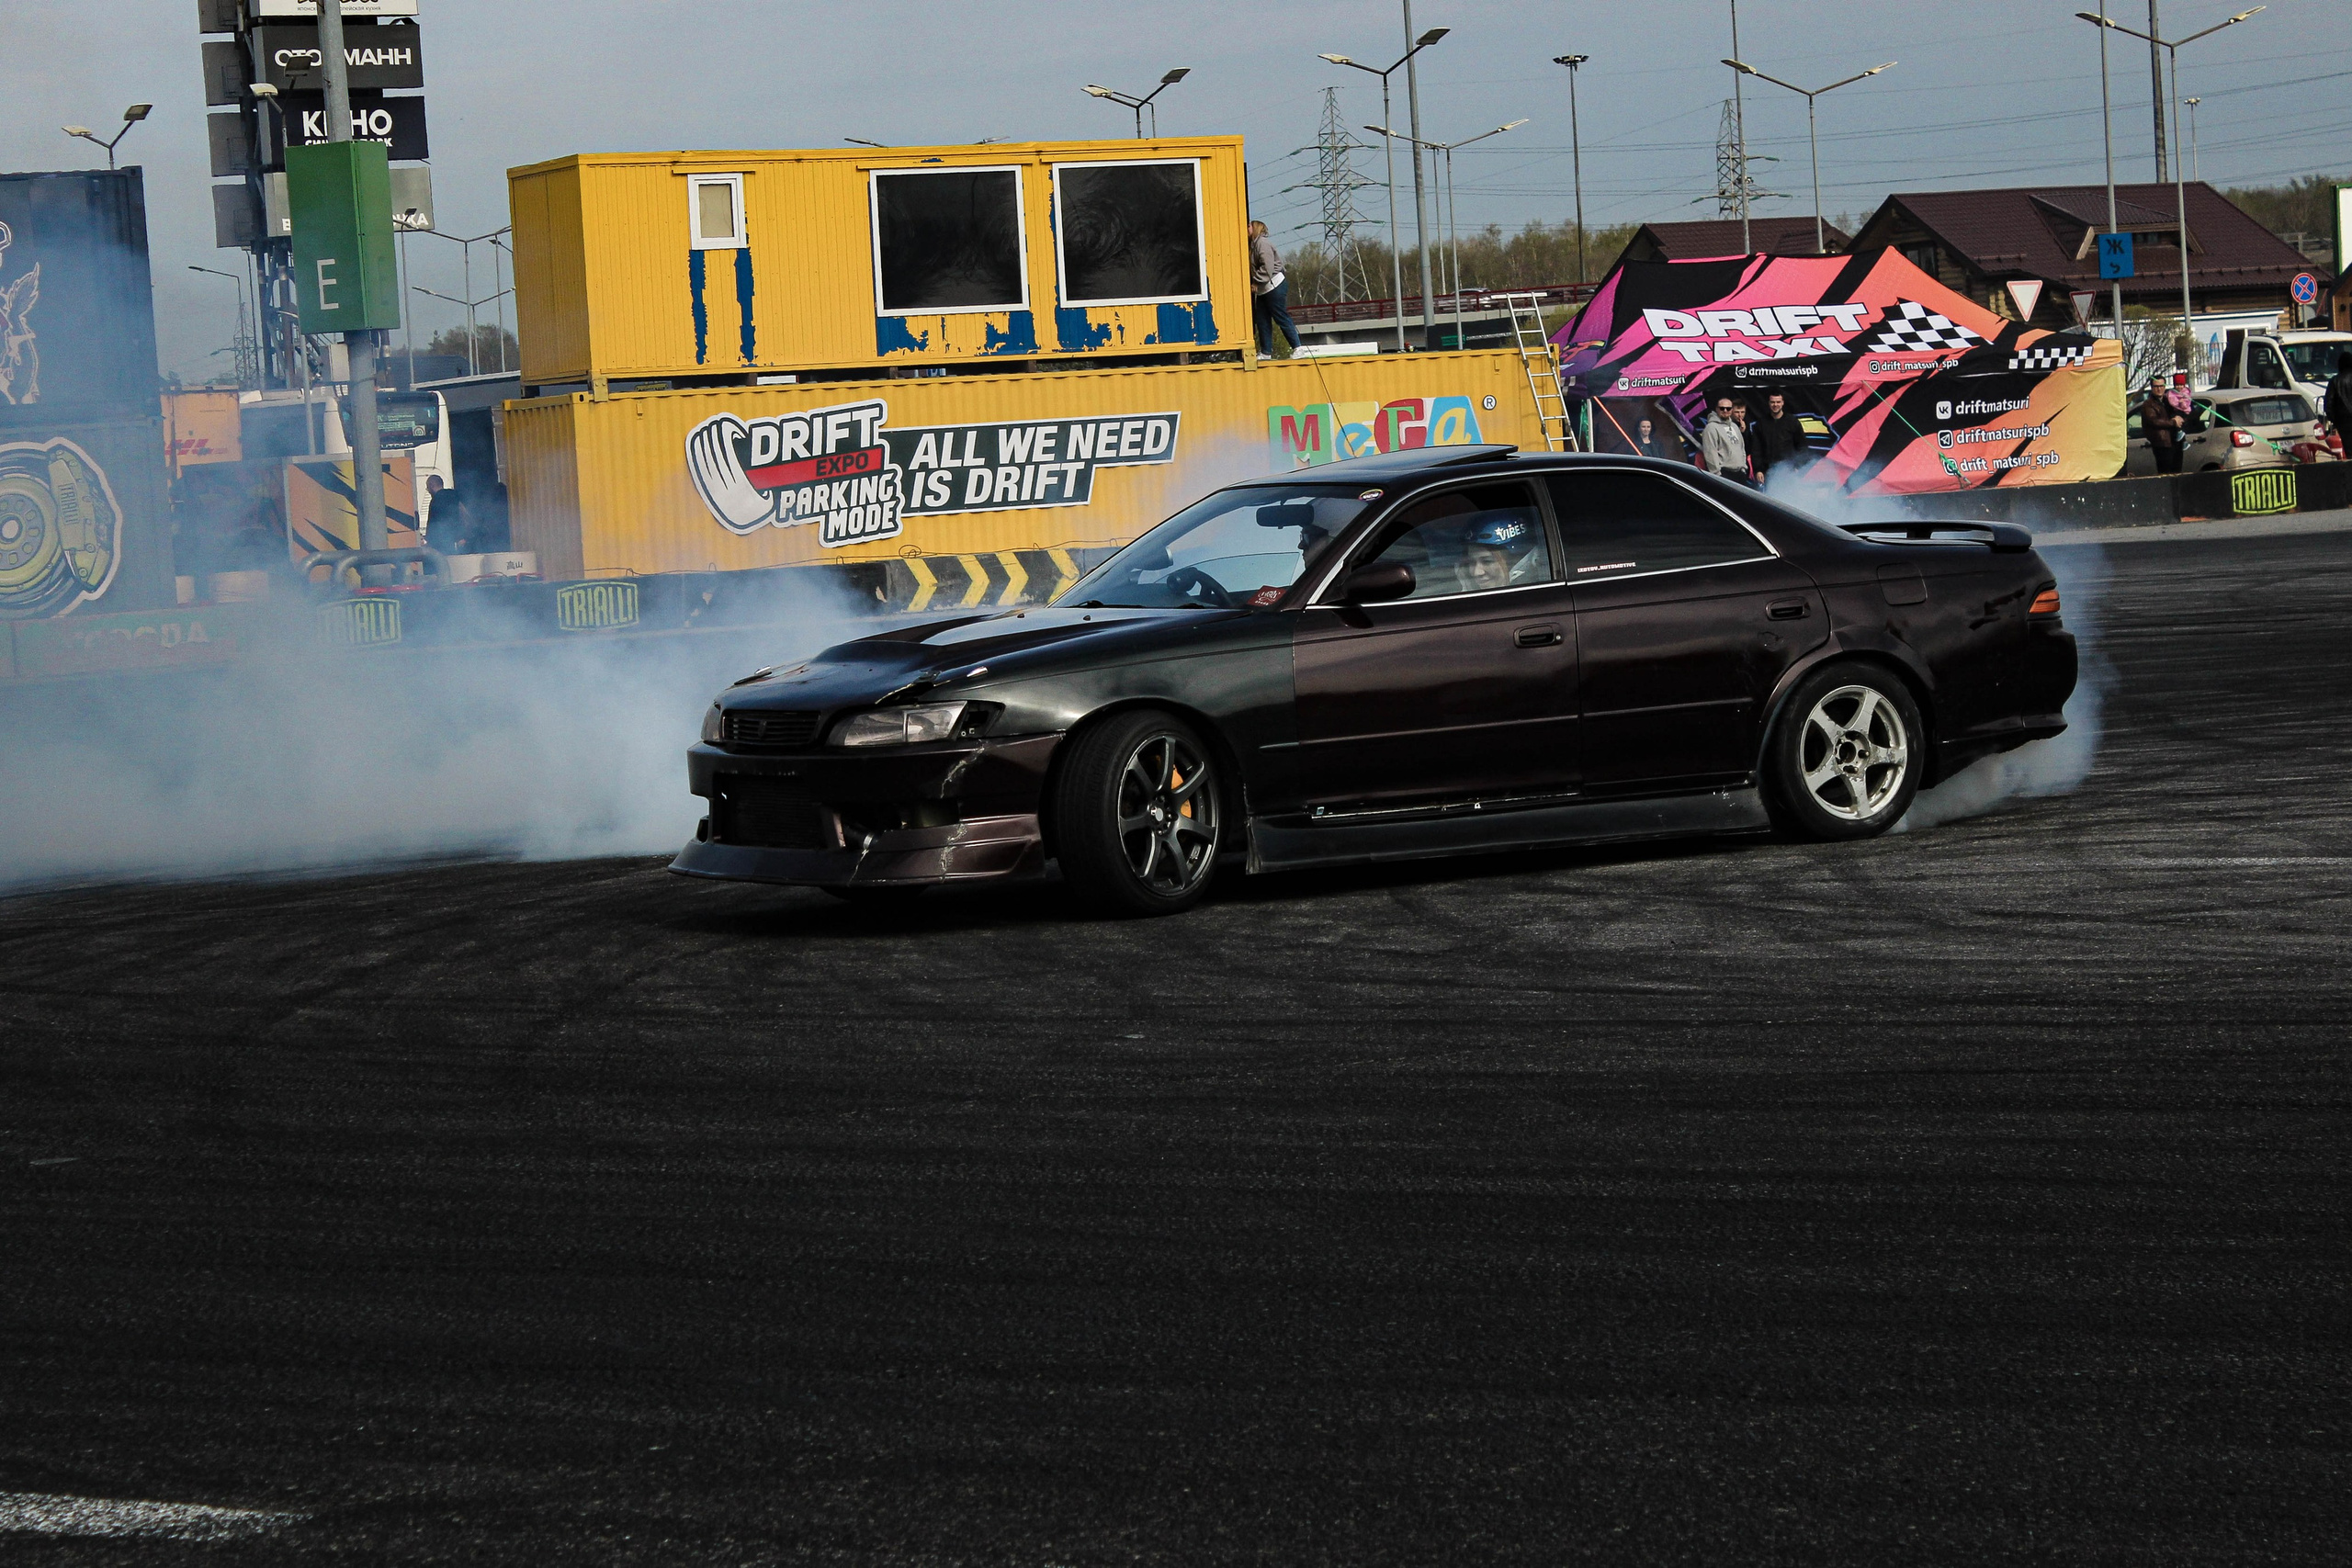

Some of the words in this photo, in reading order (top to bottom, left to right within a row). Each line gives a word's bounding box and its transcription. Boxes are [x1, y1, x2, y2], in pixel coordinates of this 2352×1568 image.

[1642, 302, 1869, 337] DRIFT
[1657, 336, 1851, 362] TAXI
[1631, 374, 1686, 389] driftmatsuri
[1955, 396, 2030, 414] driftmatsuri
[751, 407, 879, 467] DRIFT
[908, 431, 986, 470] ALL
[998, 425, 1058, 464] WE
[1066, 419, 1170, 459] NEED
[1956, 422, 2050, 445] driftmatsurispb
[816, 451, 868, 477] EXPO
[1960, 449, 2059, 474] drift_matsuri_spb
[779, 473, 894, 519] PARKING
[910, 469, 953, 508] IS
[964, 461, 1085, 504] DRIFT
[2234, 474, 2293, 511] TRIALLI
[827, 501, 896, 539] MODE
[1498, 524, 1526, 540] VIBES
[562, 586, 634, 627] TRIALLI
